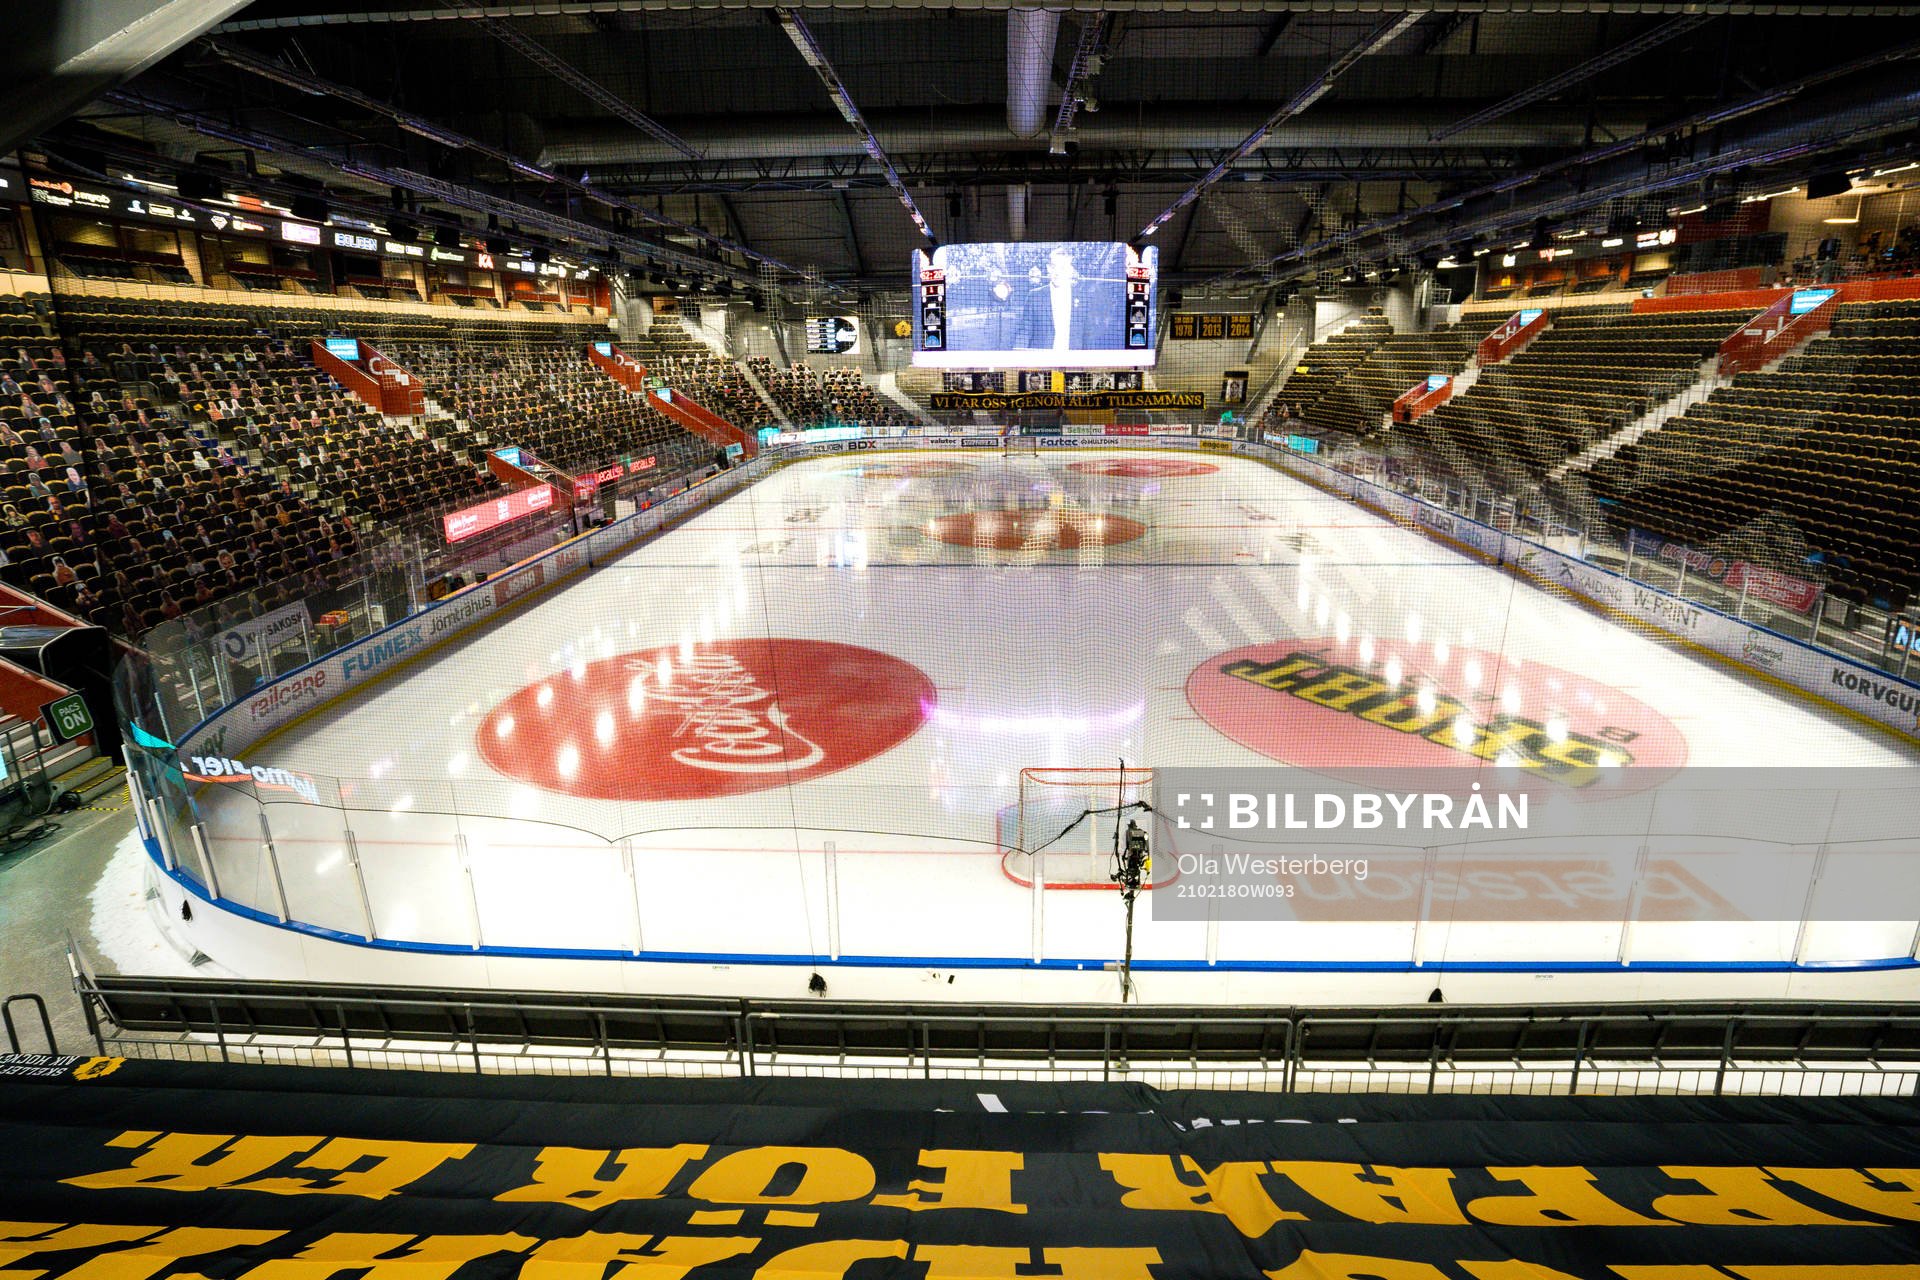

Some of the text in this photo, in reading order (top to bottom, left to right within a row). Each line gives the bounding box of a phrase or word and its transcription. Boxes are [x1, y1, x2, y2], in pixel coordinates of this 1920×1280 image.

[1175, 324, 1193, 337] 1978
[1202, 324, 1222, 337] 2013
[1230, 323, 1250, 336] 2014
[935, 395, 1202, 408] VI TAR OSS IGENOM ALLT TILLSAMMANS
[848, 440, 877, 450] BDX
[1040, 437, 1078, 446] Fastec
[342, 625, 425, 681] FUMEX
[58, 702, 81, 717] PACS
[63, 710, 86, 730] ON
[58, 1130, 478, 1199] ER
[494, 1141, 1027, 1227] FÖR
